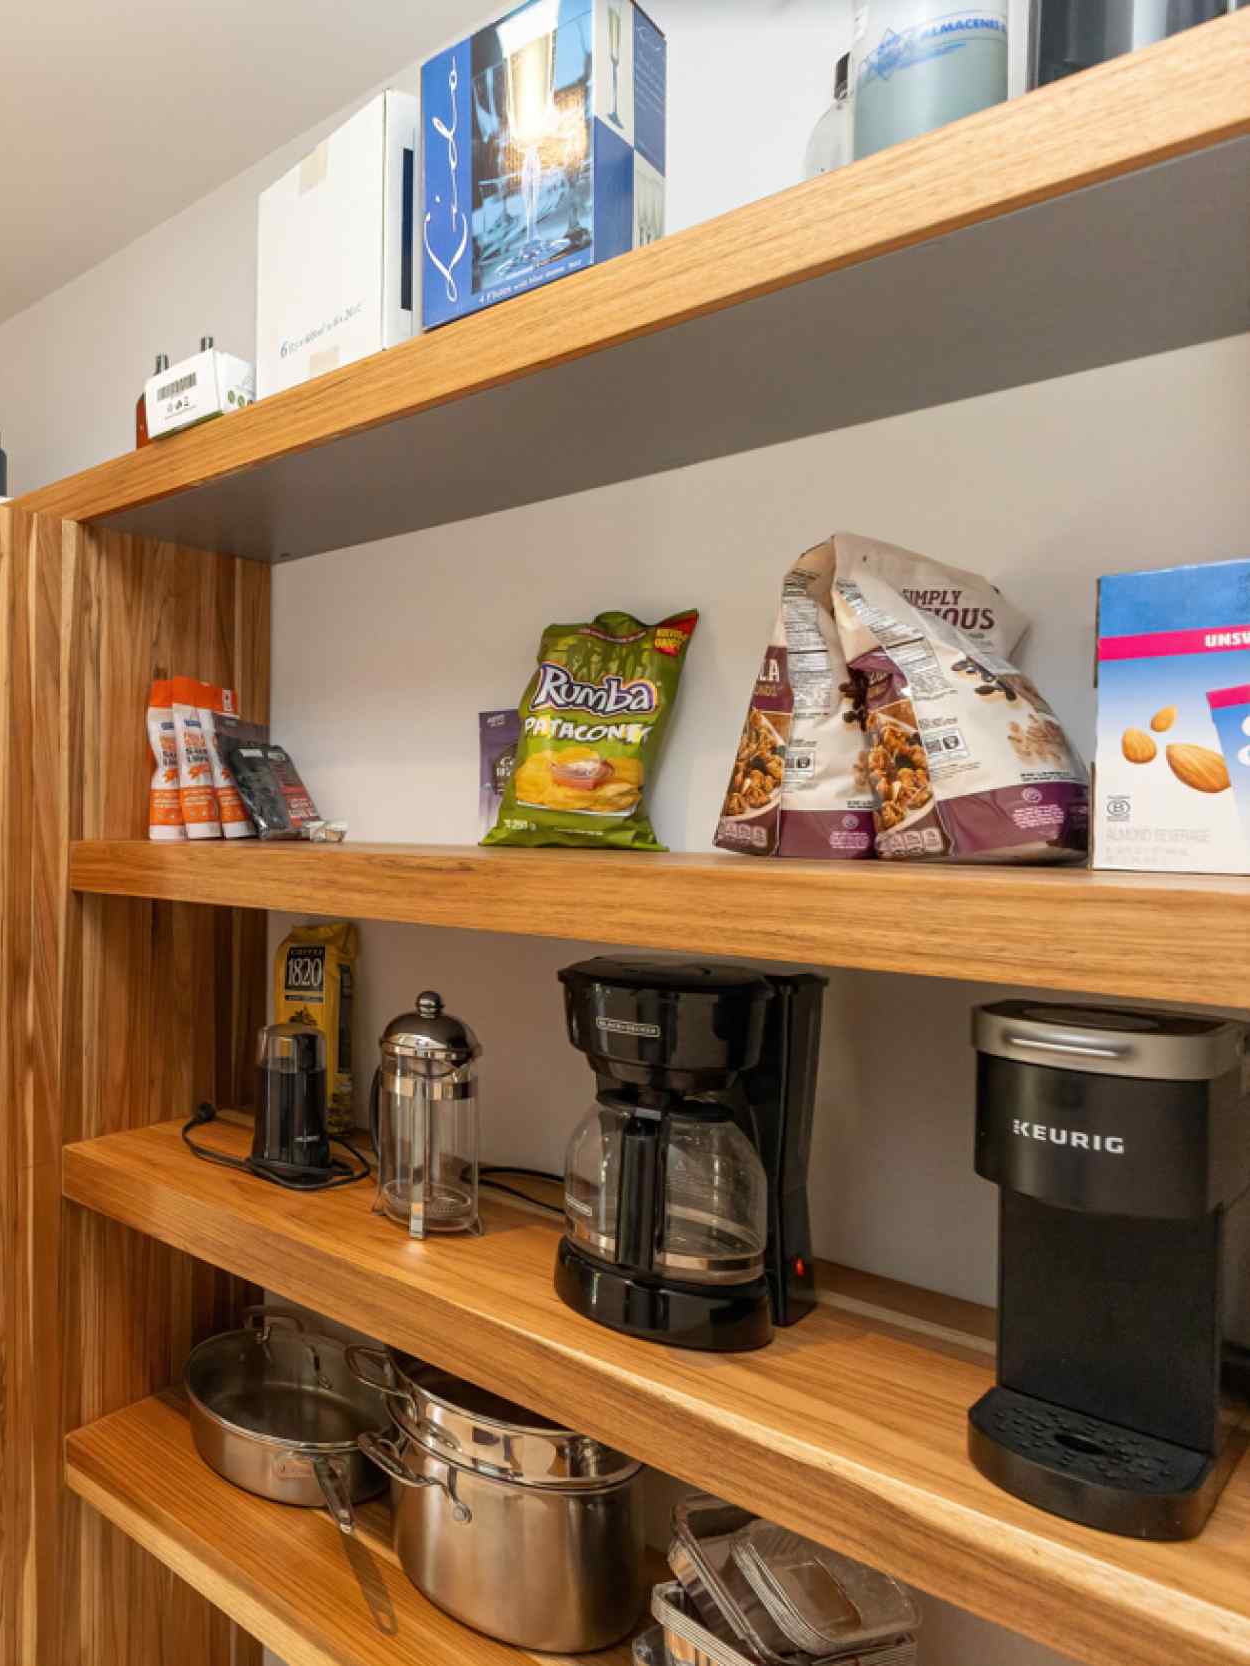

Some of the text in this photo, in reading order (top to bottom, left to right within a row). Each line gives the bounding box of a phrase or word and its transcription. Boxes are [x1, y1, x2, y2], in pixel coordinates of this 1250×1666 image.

[926, 607, 995, 630] OUS
[533, 664, 655, 714] Rumba
[1013, 1119, 1125, 1154] KEURIG
